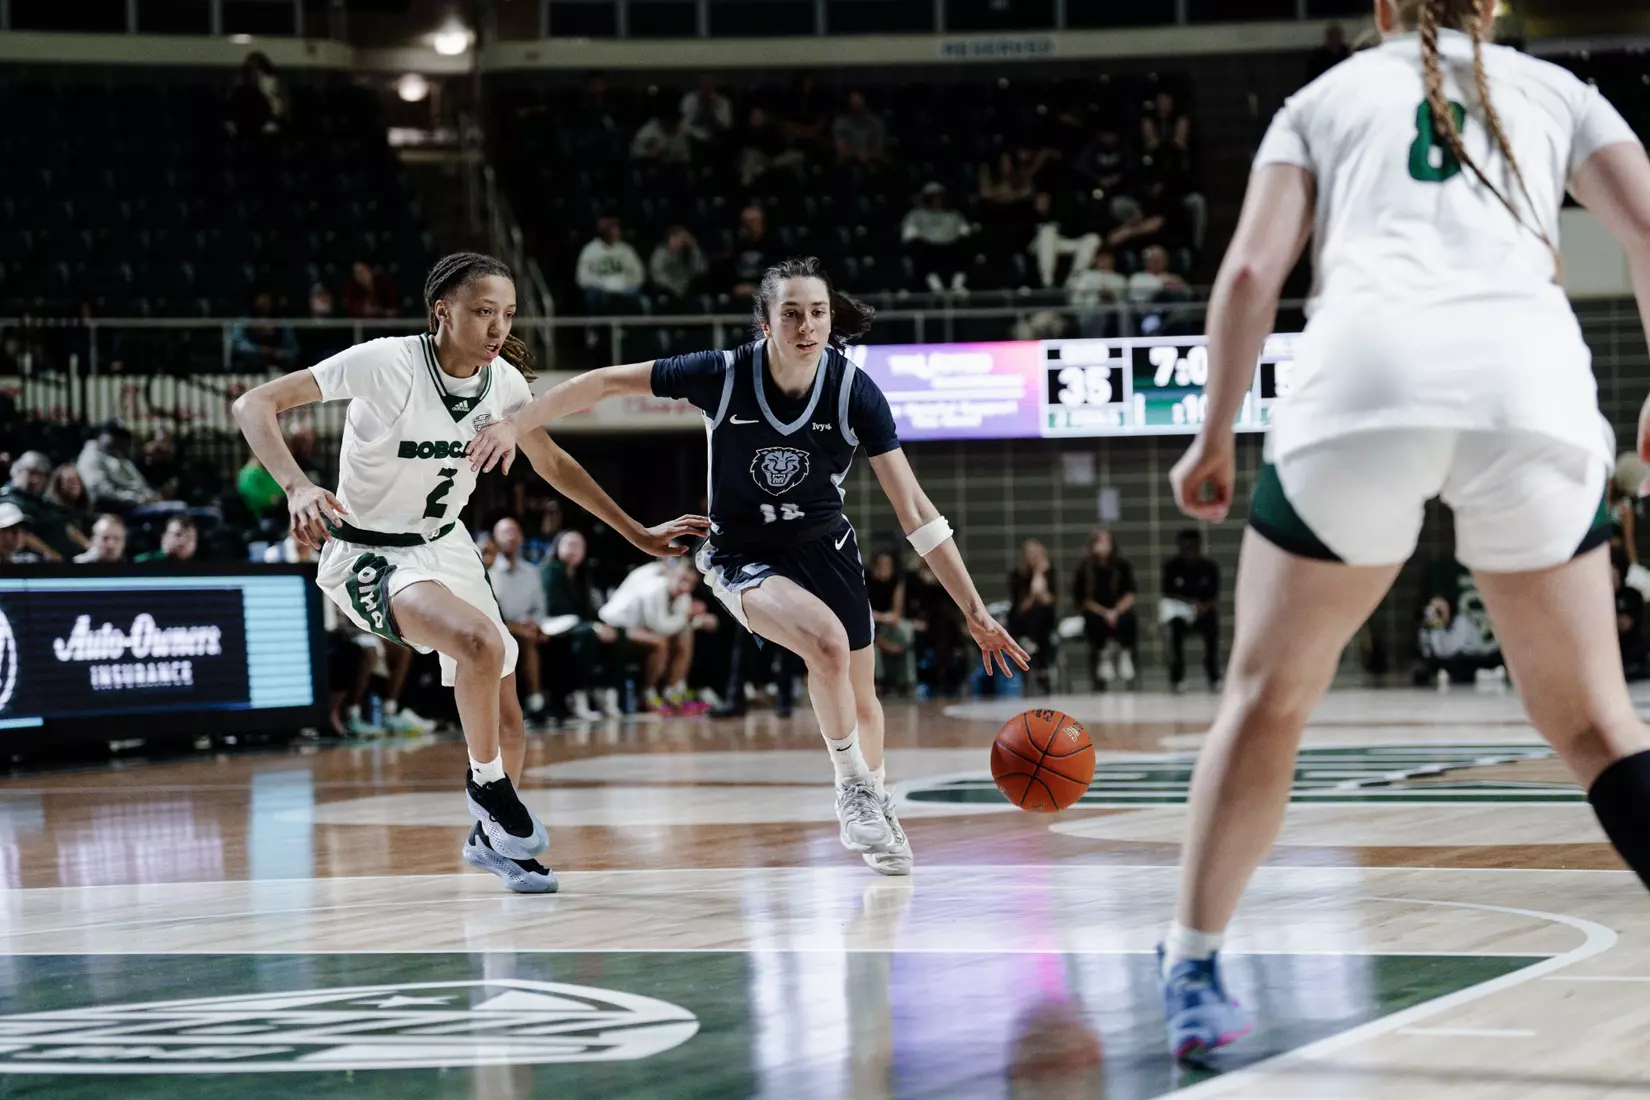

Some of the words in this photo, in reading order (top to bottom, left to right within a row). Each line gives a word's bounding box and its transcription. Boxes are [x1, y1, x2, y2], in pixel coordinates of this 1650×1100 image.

[1407, 98, 1465, 181] 8
[1058, 366, 1112, 407] 35
[1149, 346, 1208, 387] 7:0
[422, 467, 458, 519] 2
[53, 613, 222, 662] Auto-Owners
[90, 660, 193, 690] INSURANCE
